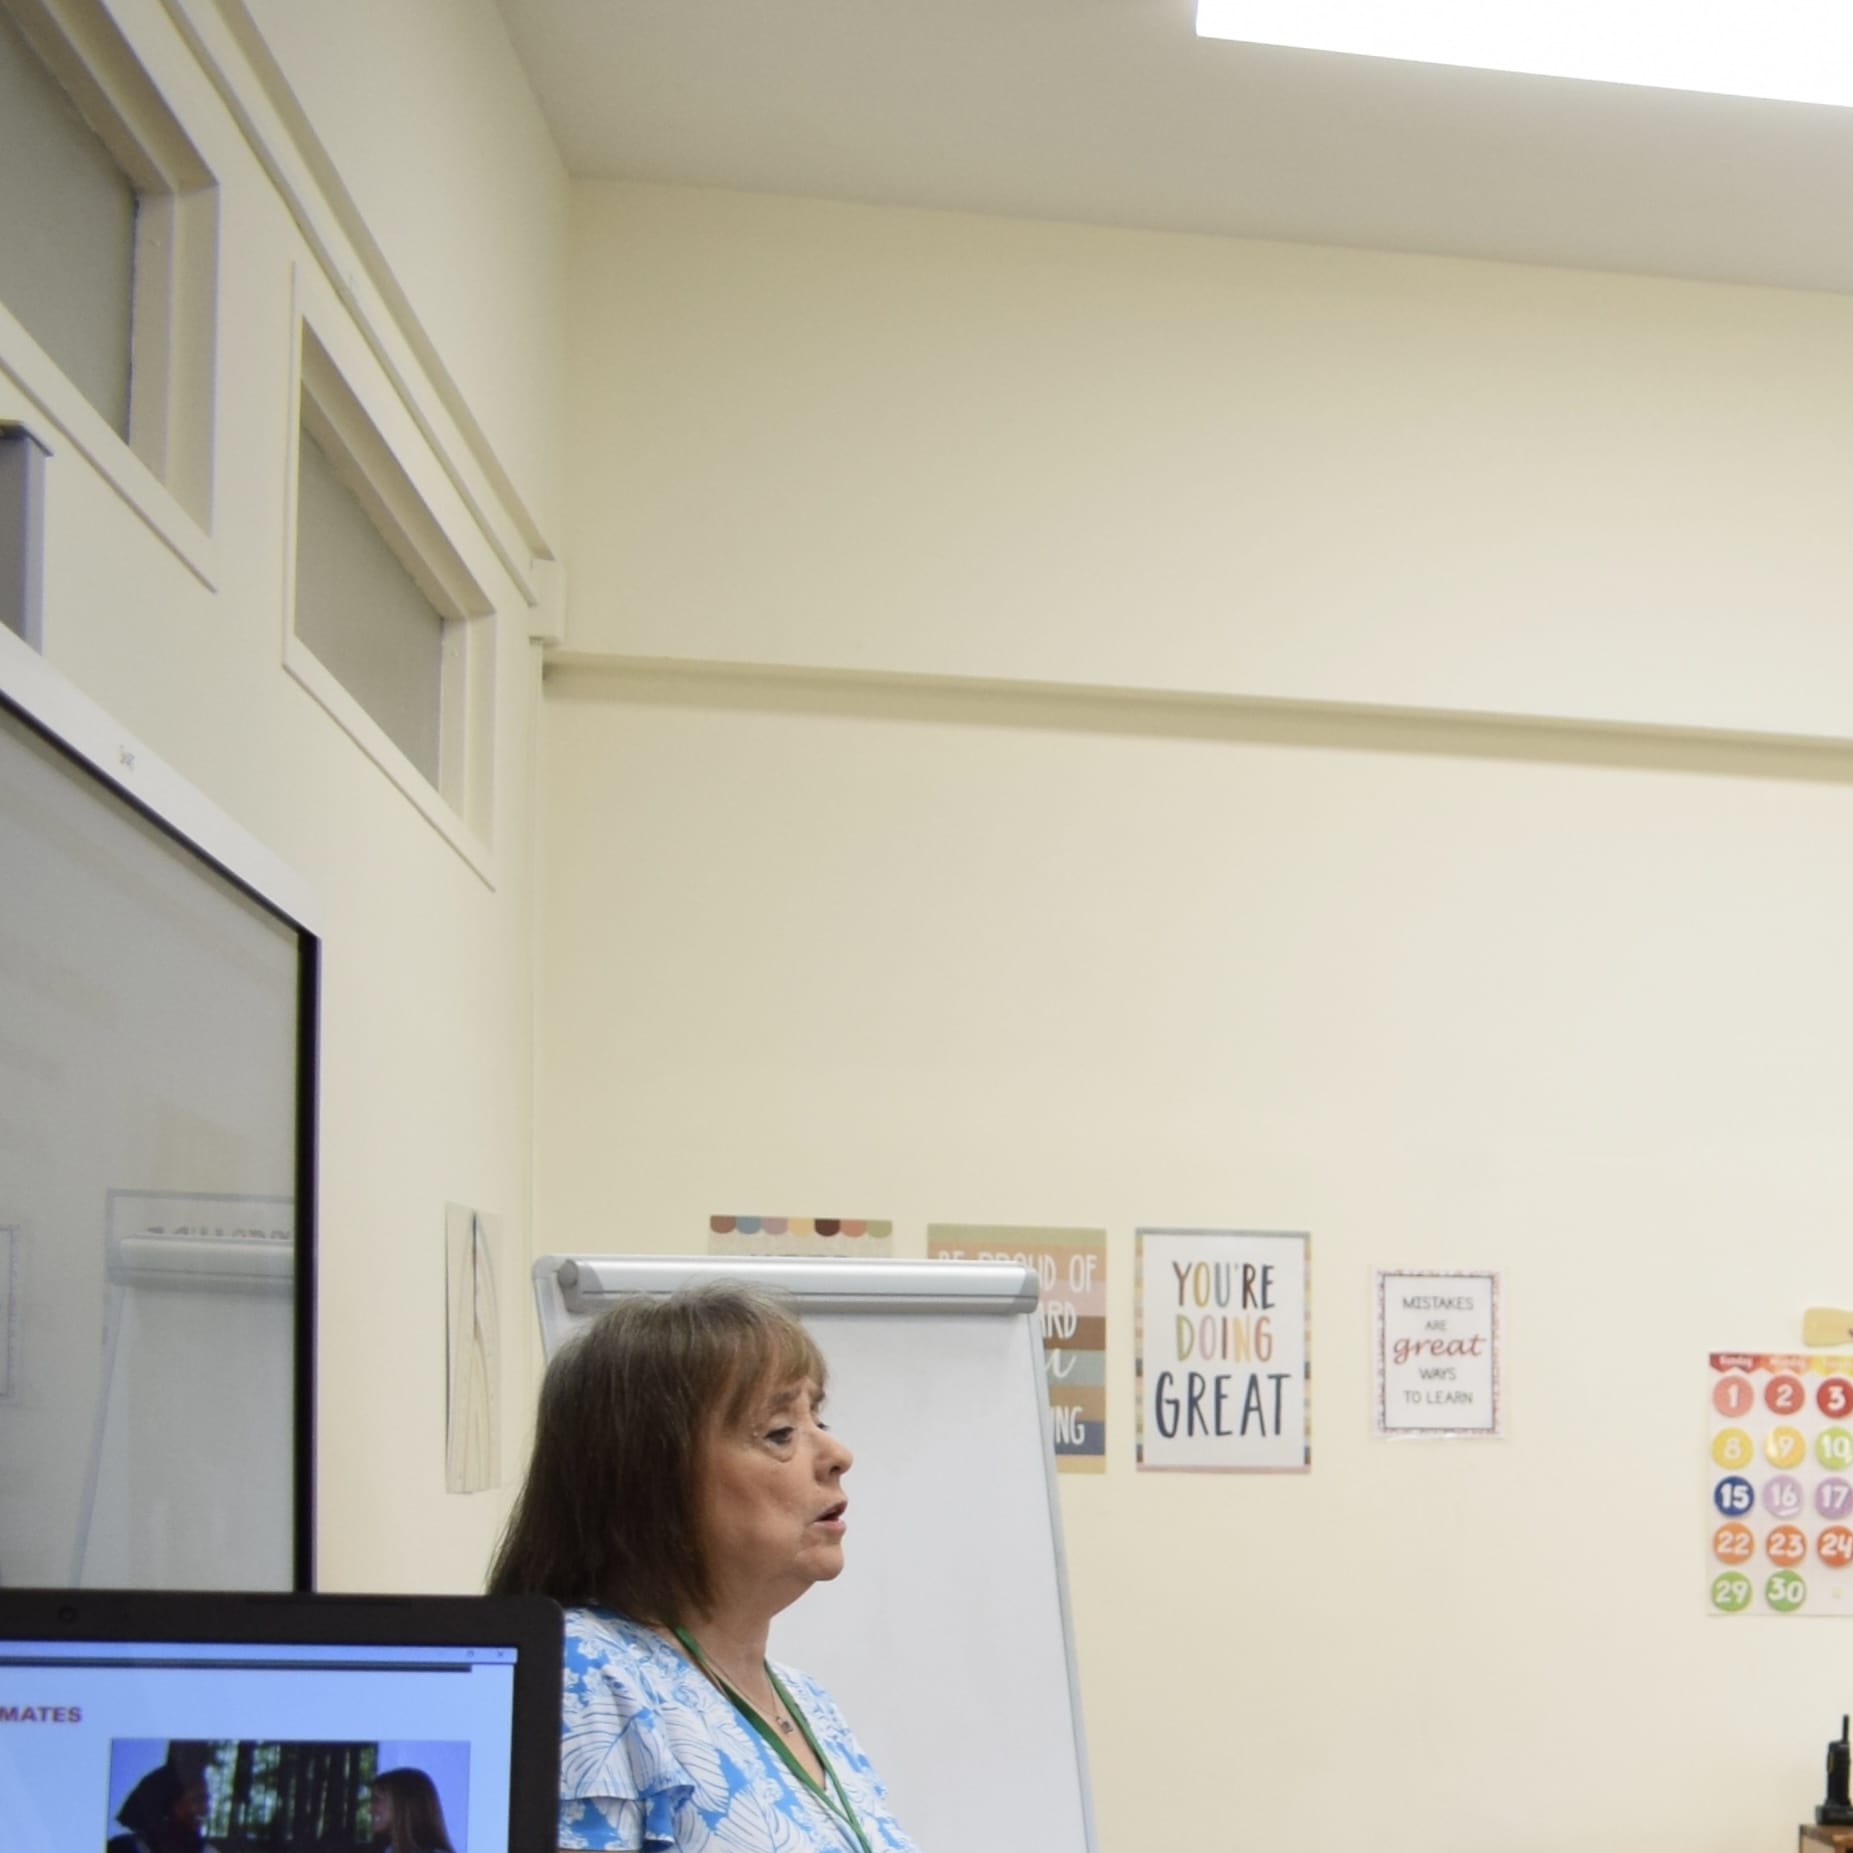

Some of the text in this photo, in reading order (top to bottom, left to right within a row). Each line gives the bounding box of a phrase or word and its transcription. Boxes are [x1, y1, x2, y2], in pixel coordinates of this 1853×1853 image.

[1068, 1254, 1098, 1293] OF
[1171, 1260, 1276, 1310] YOU'RE
[1402, 1296, 1474, 1311] MISTAKES
[1425, 1319, 1446, 1331] ARE
[1176, 1315, 1273, 1363] DOING
[1393, 1334, 1487, 1364] great
[1418, 1367, 1456, 1381] WAYS
[1155, 1371, 1291, 1438] GREAT
[1403, 1390, 1474, 1405] TO LEARN
[1726, 1387, 1739, 1408] 1
[1777, 1386, 1795, 1408] 2
[1827, 1386, 1846, 1411] 3
[1724, 1437, 1740, 1458] 8
[1777, 1436, 1794, 1459] 9
[1821, 1437, 1850, 1458] 10
[1721, 1484, 1749, 1509] 15
[1771, 1483, 1798, 1507] 16
[1821, 1485, 1848, 1508] 17
[1717, 1531, 1749, 1555] 22
[1769, 1534, 1803, 1558] 23
[1821, 1534, 1853, 1559] 24
[1716, 1577, 1804, 1604] 29 30
